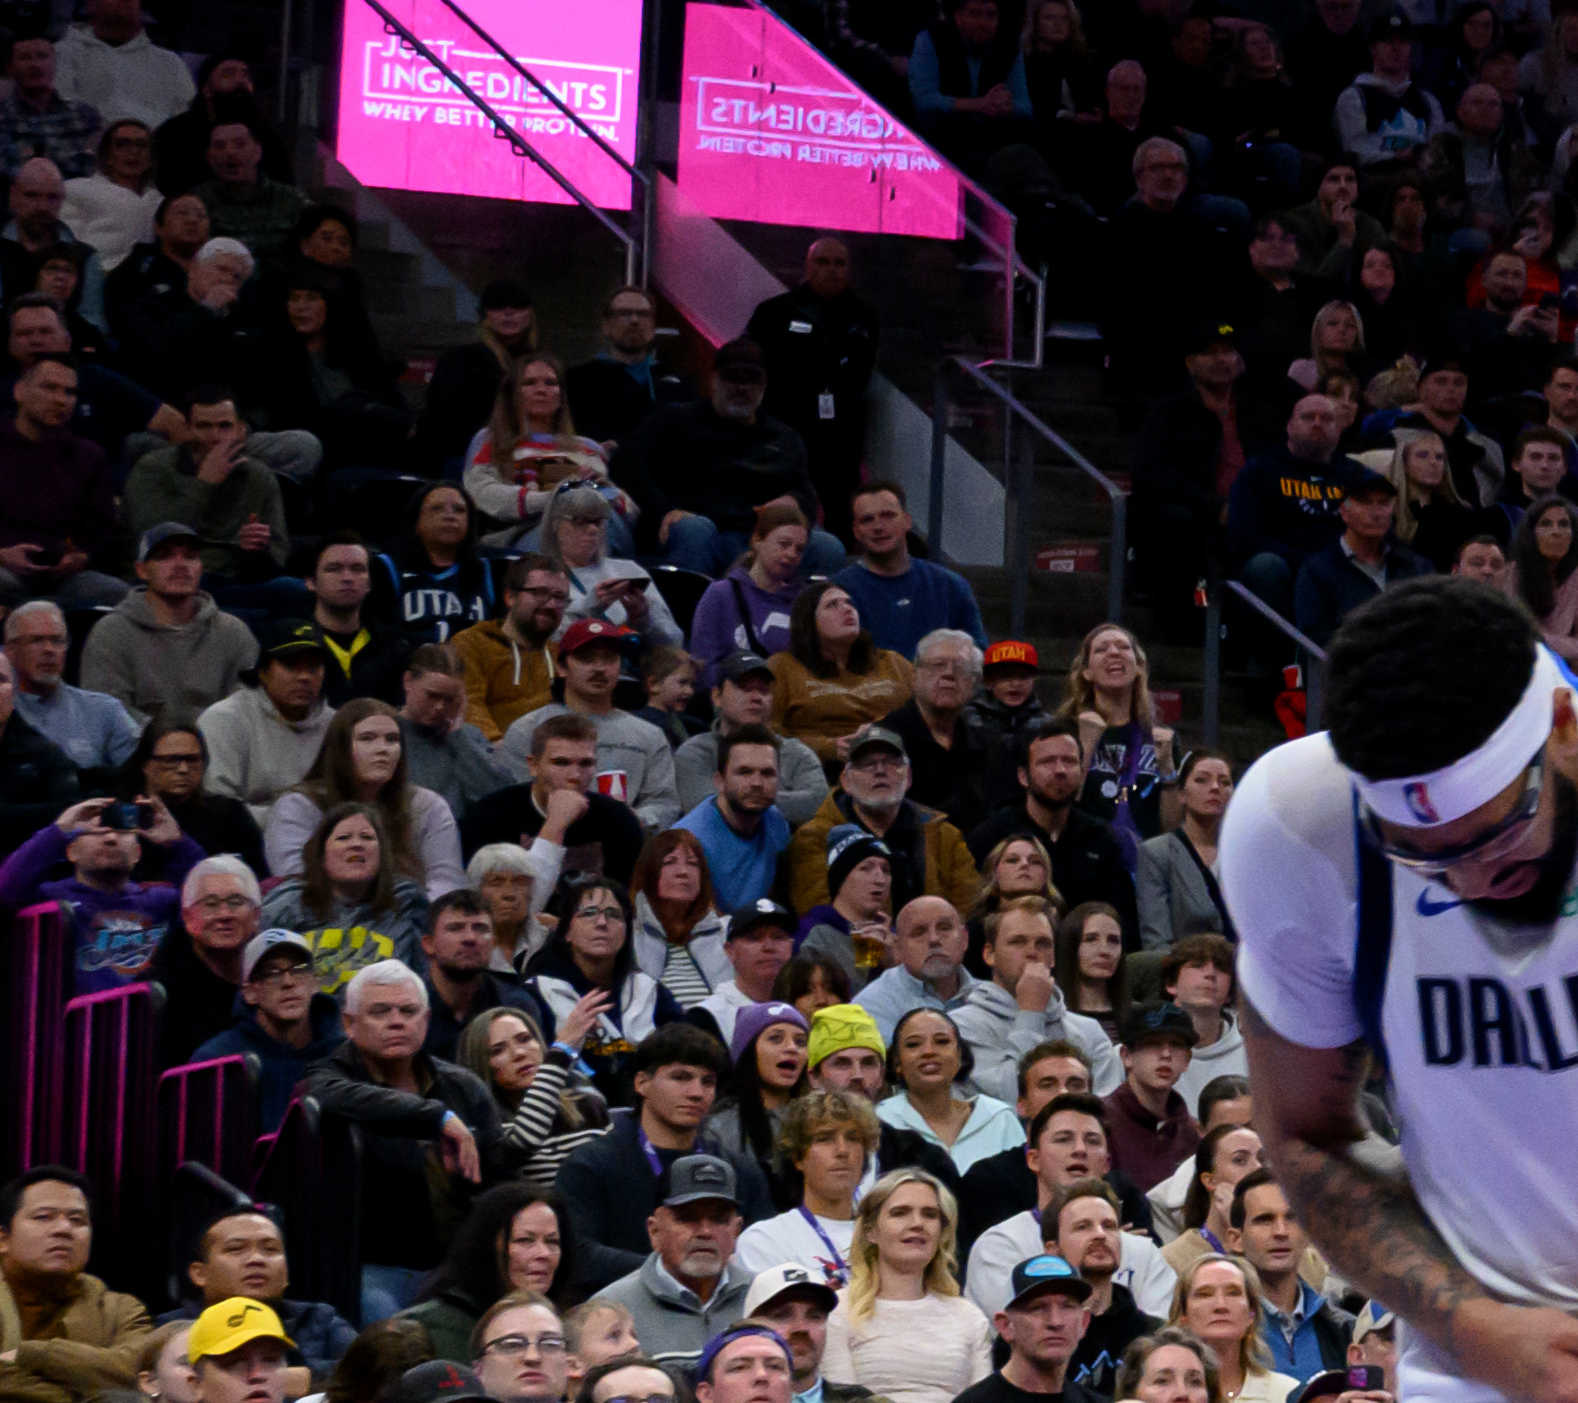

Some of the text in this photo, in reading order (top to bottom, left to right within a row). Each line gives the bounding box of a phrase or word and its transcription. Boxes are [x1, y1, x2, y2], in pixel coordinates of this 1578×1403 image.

[363, 101, 425, 124] WHEY
[1279, 476, 1322, 502] UTAH
[992, 645, 1025, 665] UTAH
